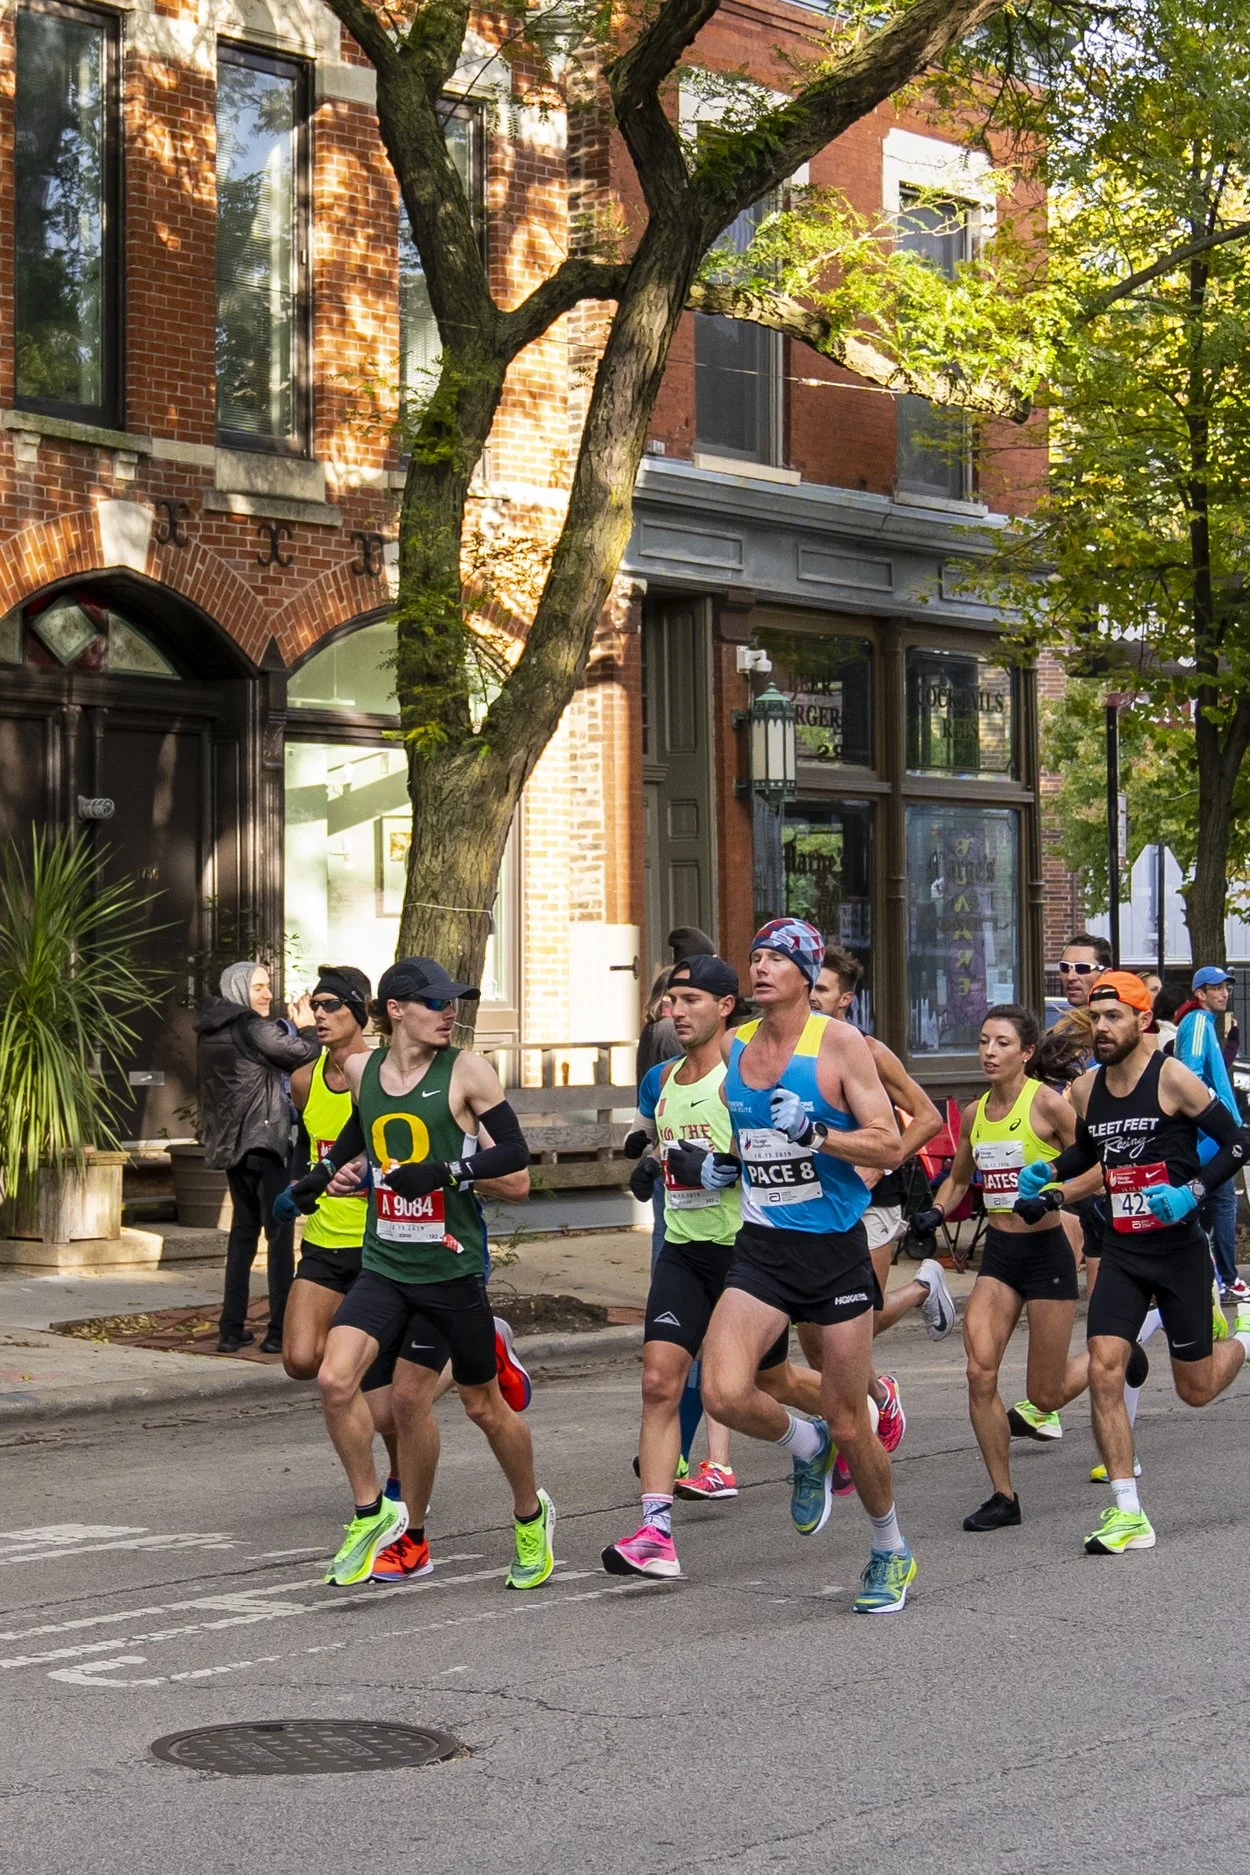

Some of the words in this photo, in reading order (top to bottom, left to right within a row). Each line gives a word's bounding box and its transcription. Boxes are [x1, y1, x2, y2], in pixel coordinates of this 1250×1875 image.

[915, 686, 1004, 713] COCKTAILS
[942, 718, 978, 739] RIBS
[371, 1112, 430, 1164] O
[1088, 1119, 1123, 1137] FLEET
[1122, 1117, 1159, 1132] FEET
[1097, 1136, 1156, 1162] Racing
[747, 1164, 796, 1185] PACE
[800, 1162, 814, 1179] 8
[382, 1194, 391, 1215] A
[393, 1195, 434, 1217] 9084
